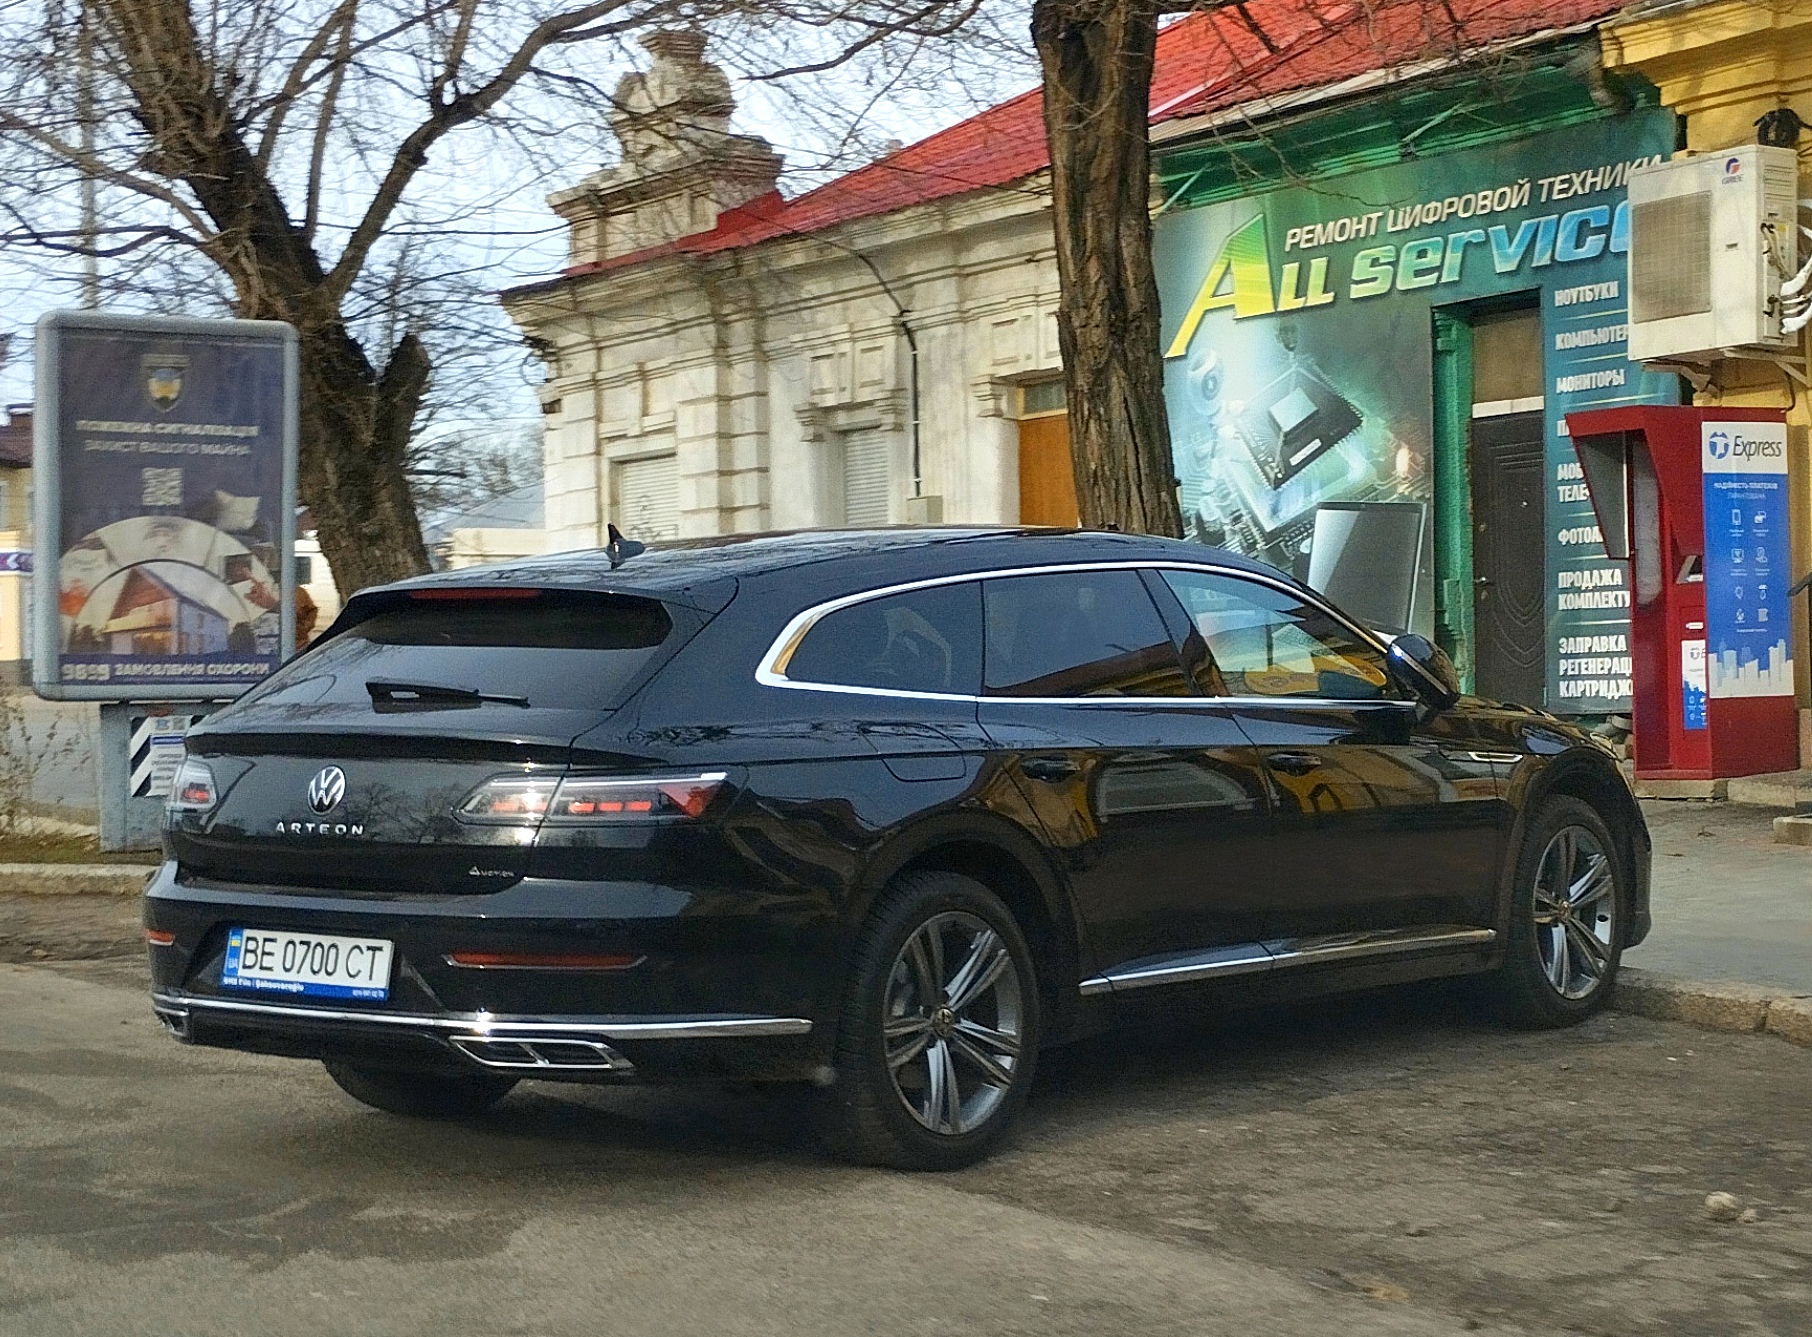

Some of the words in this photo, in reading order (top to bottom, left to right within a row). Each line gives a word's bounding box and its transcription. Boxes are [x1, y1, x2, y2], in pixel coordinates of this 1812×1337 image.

[1285, 211, 1385, 252] РЕМОНТ
[1387, 179, 1531, 232] ЦИФРОВОЙ
[1554, 280, 1620, 307] НОУТБУКИ
[1556, 368, 1625, 394] МОНИТОРЫ
[1732, 435, 1783, 462] Express
[1558, 568, 1623, 590] ПРОДАЖА
[1558, 634, 1627, 654] ЗАПРАВКА
[276, 821, 364, 835] ARTEON
[242, 936, 278, 972] BE
[282, 938, 340, 977] 0700
[345, 944, 384, 981] CT
